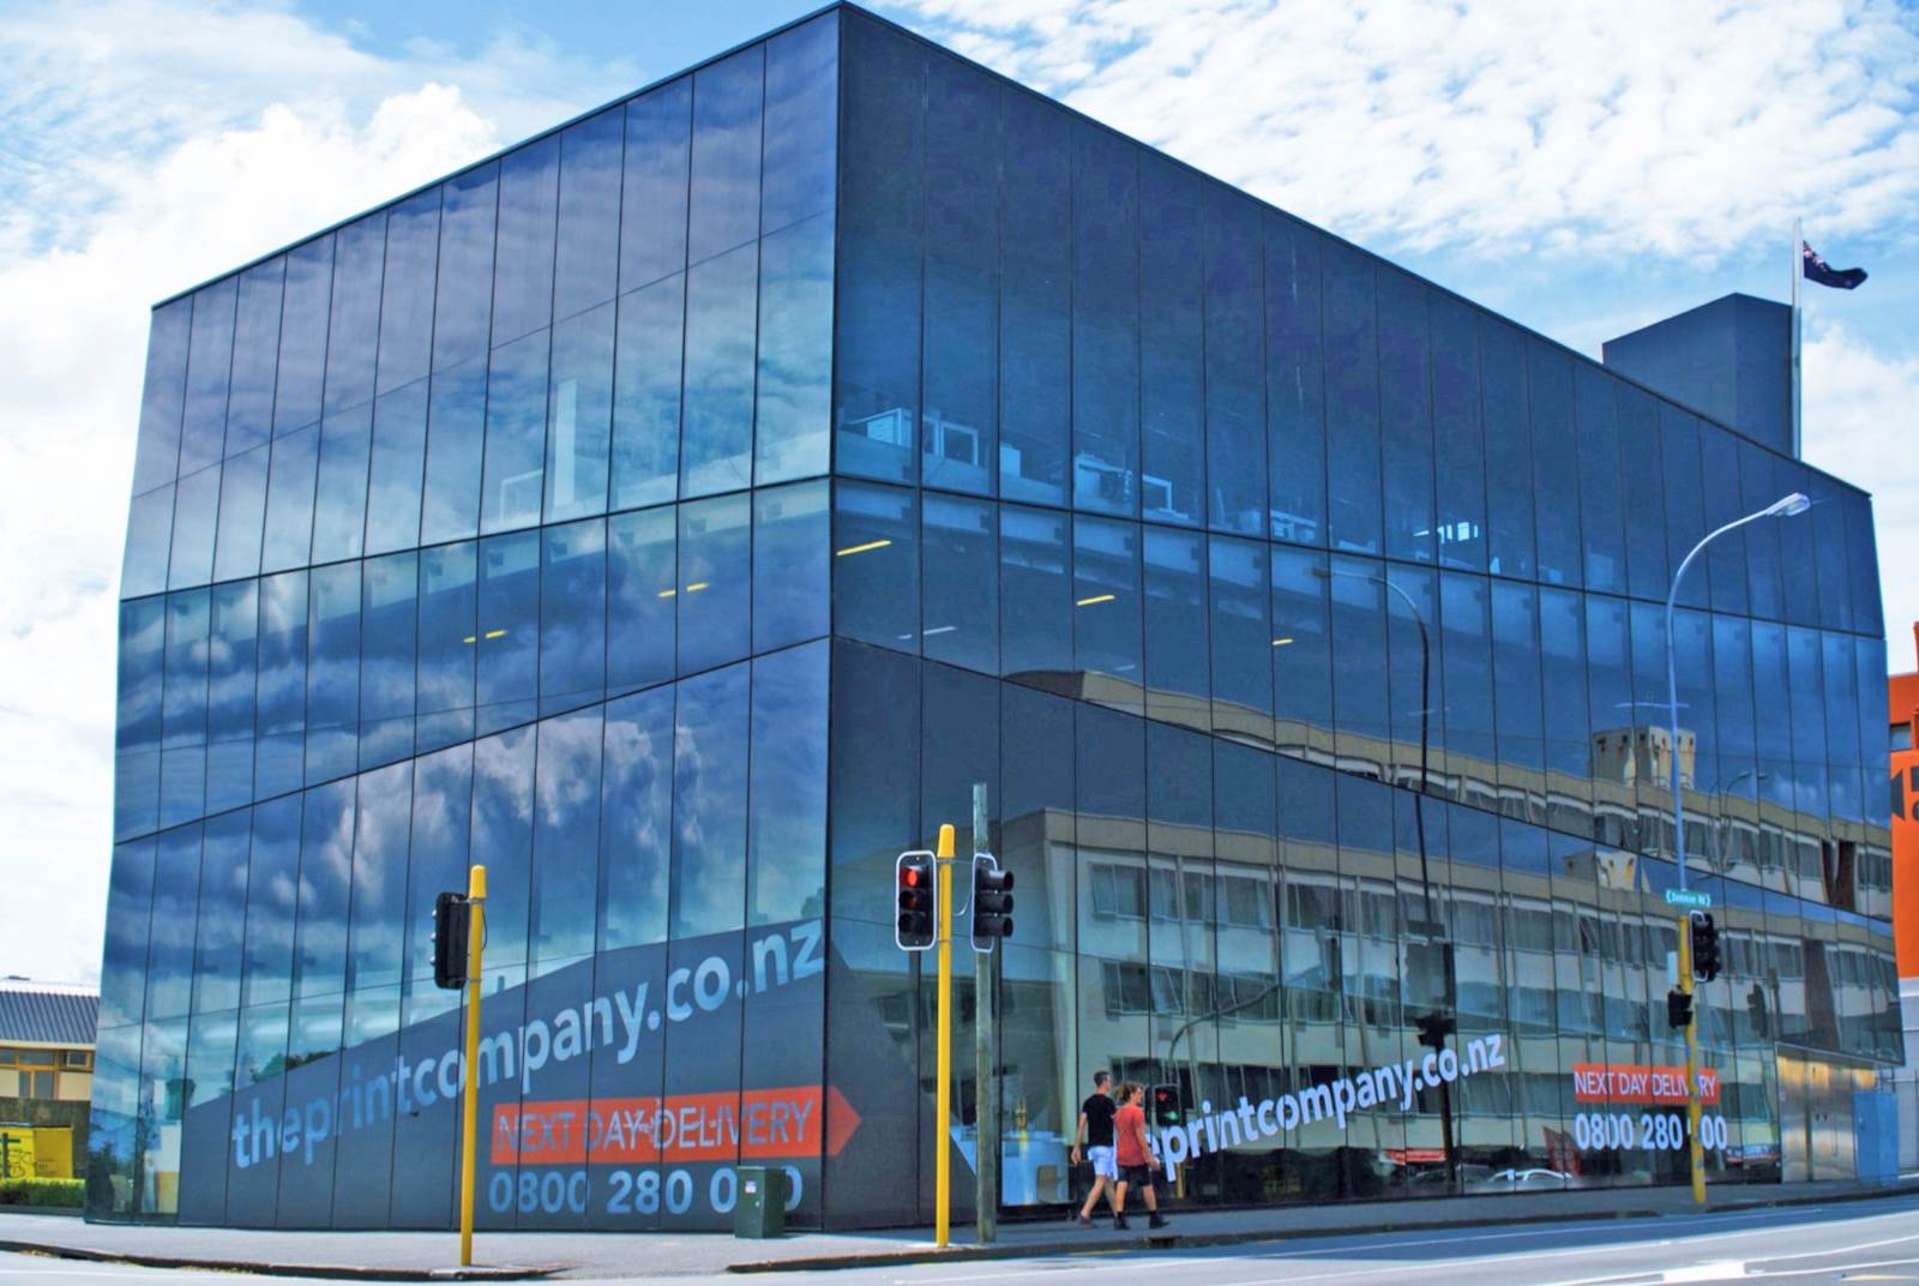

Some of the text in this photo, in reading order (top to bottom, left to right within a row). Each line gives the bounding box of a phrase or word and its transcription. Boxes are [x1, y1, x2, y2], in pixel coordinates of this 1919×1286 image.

[231, 919, 825, 1169] theprintcompany.co.nz
[1144, 1033, 1505, 1182] printcompany.co.nz
[1573, 1071, 1717, 1097] NEXT DAY DELIRY
[498, 1098, 814, 1152] NEXT DAY DELIVERY
[1574, 1112, 1728, 1151] 0800 280 00
[488, 1165, 803, 1215] 0800 280 00
